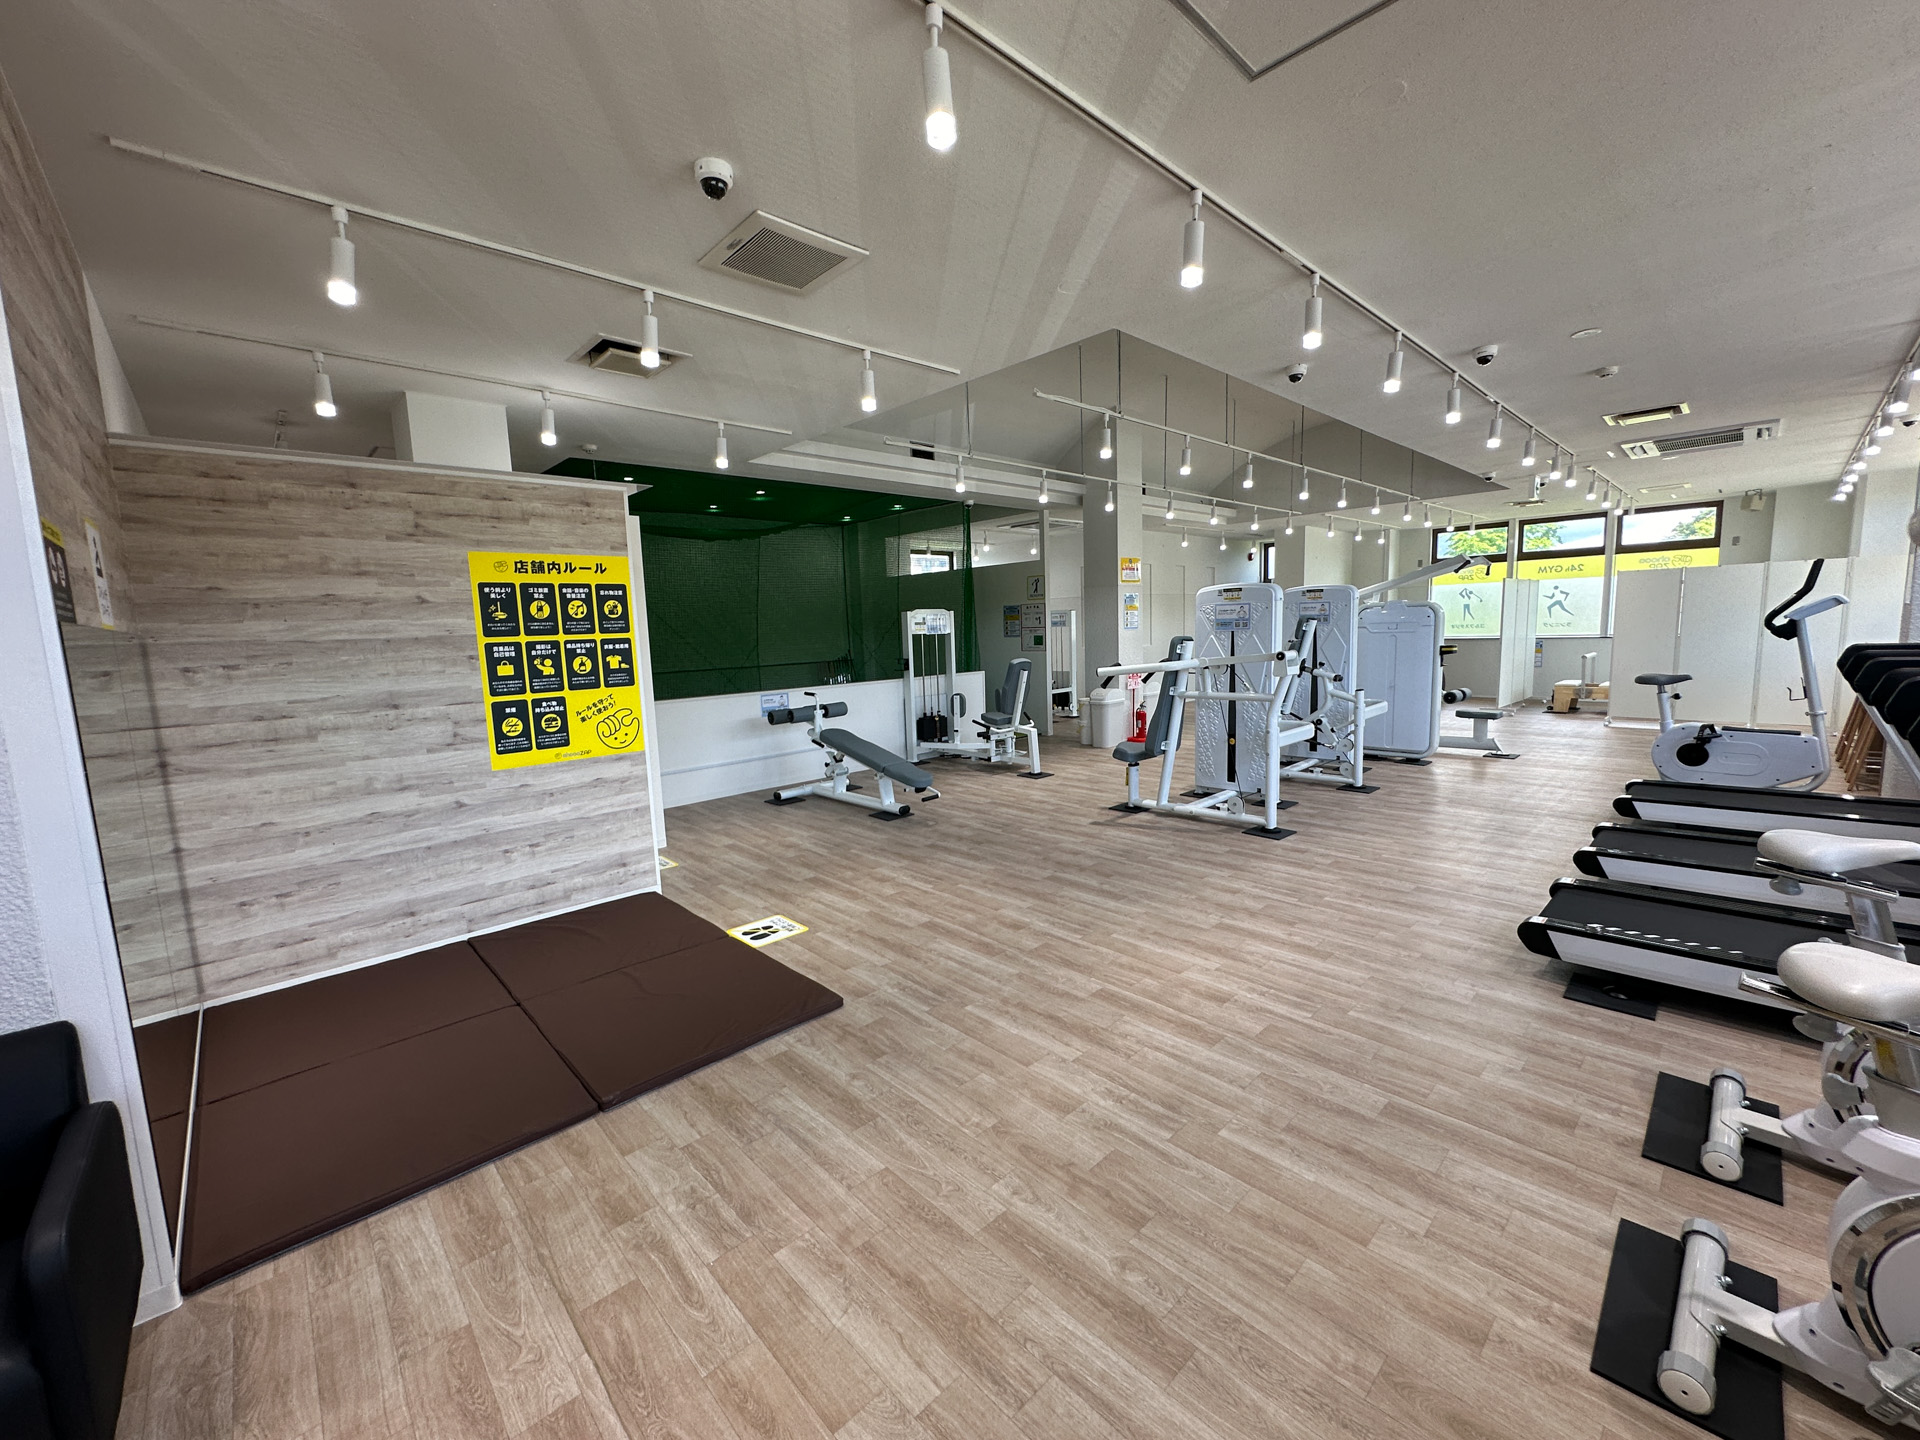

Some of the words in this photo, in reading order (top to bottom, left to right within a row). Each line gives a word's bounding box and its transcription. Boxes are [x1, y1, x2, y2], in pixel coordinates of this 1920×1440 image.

[514, 560, 607, 574] 店舗内ルール
[576, 693, 614, 717] ルールを守って
